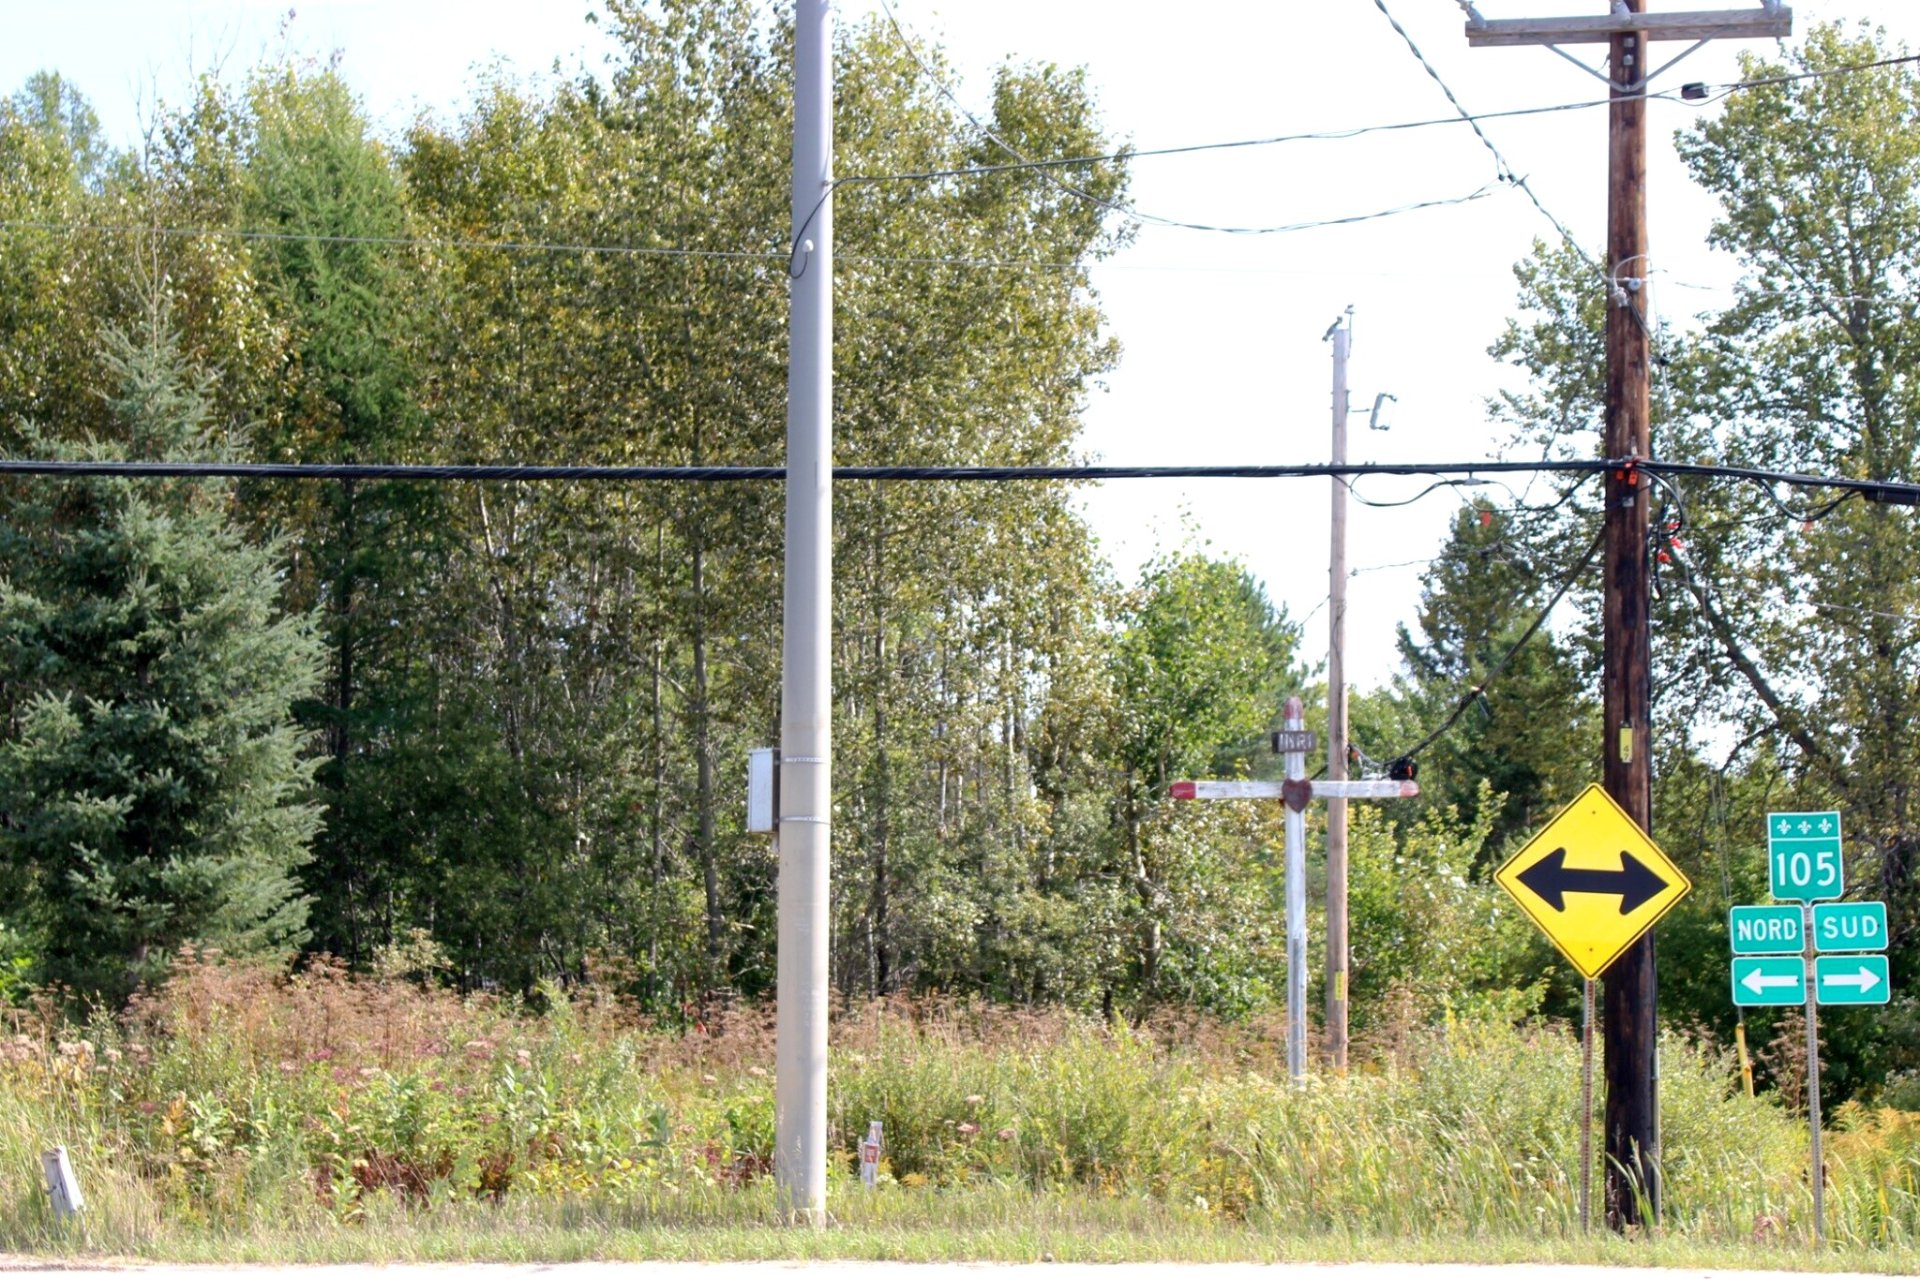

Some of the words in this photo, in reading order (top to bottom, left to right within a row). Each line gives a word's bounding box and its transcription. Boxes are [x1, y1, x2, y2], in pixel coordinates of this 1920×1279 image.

[1776, 852, 1836, 886] 105
[1738, 918, 1797, 941] NORD
[1823, 915, 1878, 939] SUD
